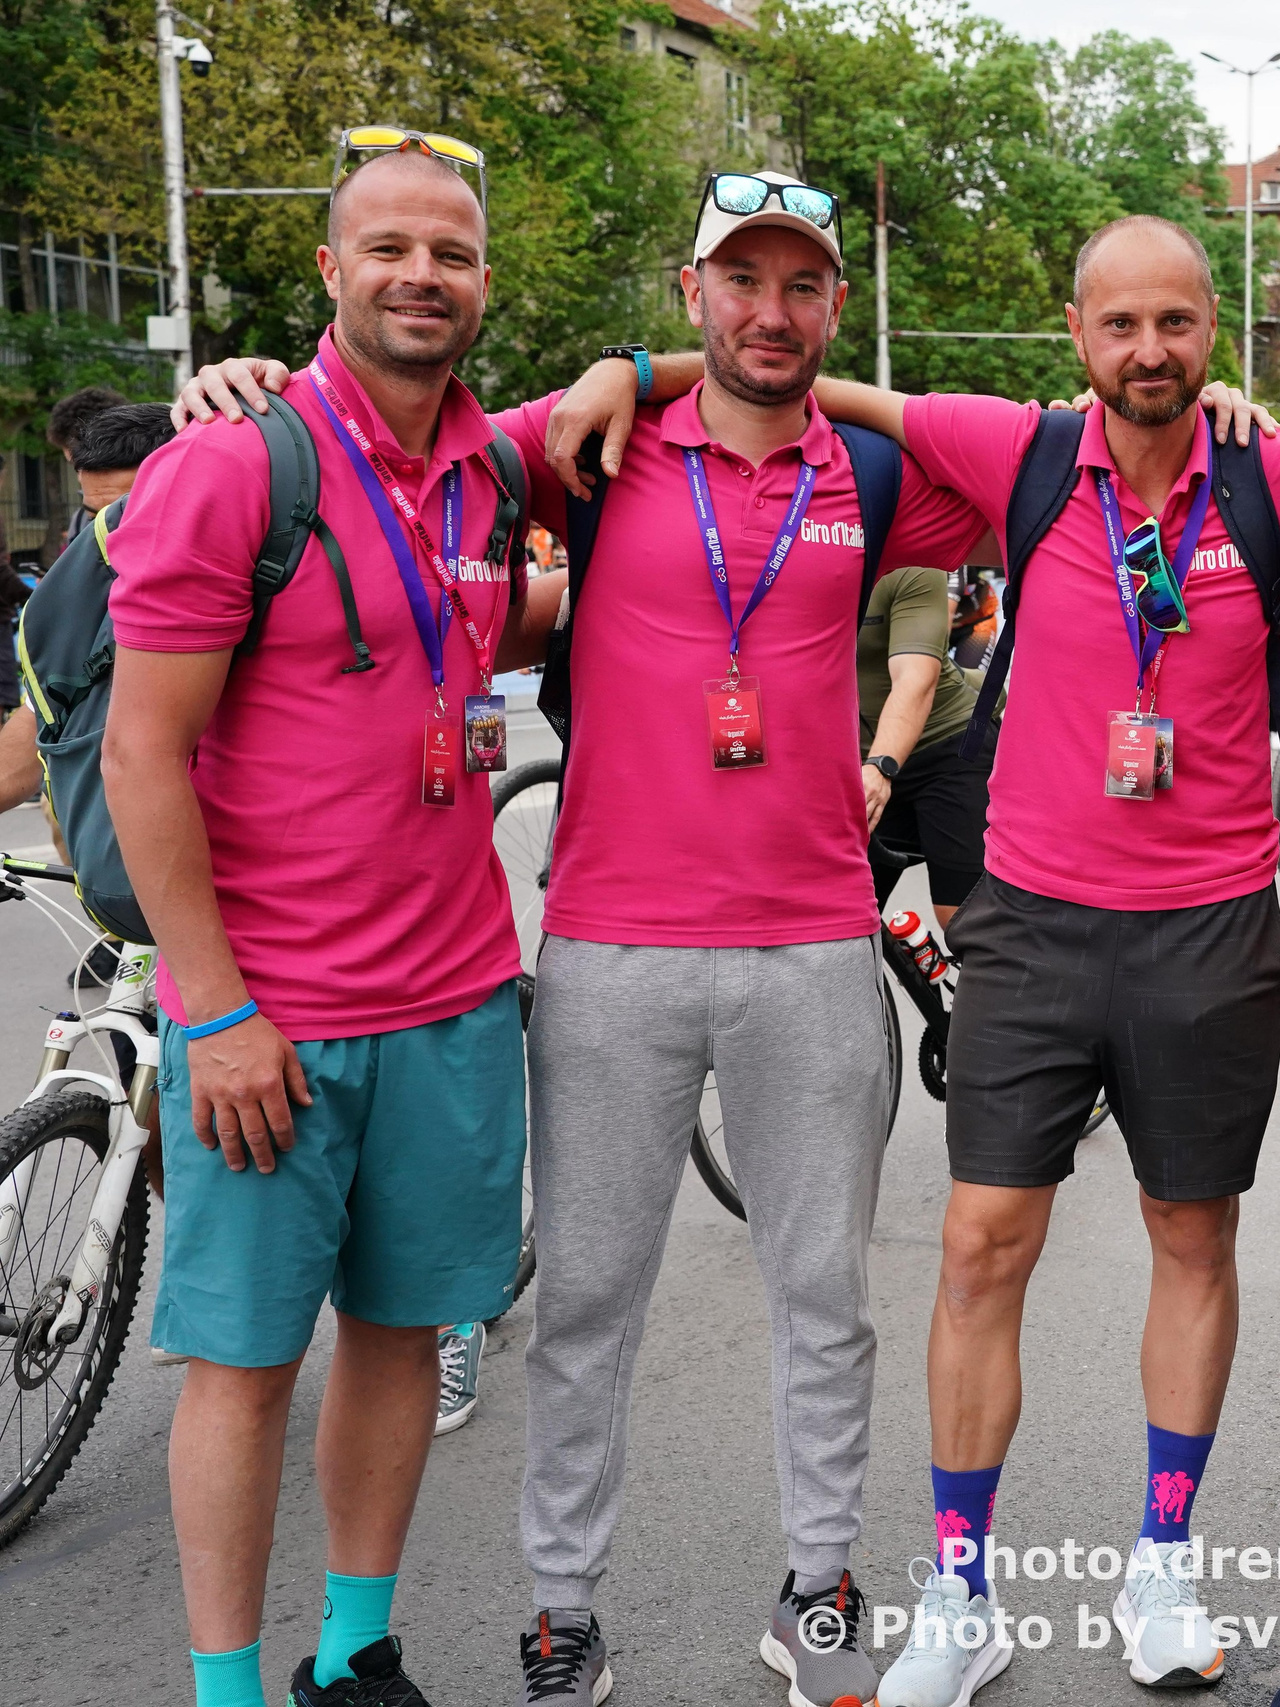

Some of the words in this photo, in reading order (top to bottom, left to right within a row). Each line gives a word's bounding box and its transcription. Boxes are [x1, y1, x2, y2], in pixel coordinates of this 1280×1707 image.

[358, 432, 371, 450] Giro
[692, 474, 702, 498] Partenza
[402, 503, 416, 518] Giro
[698, 498, 706, 518] Grande
[768, 554, 784, 570] Giro
[776, 534, 792, 558] d'Italia
[788, 506, 798, 526] Grande
[794, 484, 806, 506] Partenza
[801, 518, 830, 544] Giro
[831, 521, 864, 548] d'Italia
[1106, 510, 1114, 536] Partenza
[706, 526, 720, 550] d'Italia
[1110, 536, 1118, 556] Grande
[712, 550, 724, 566] Giro
[442, 571, 454, 586] Giro
[458, 555, 484, 582] Giro
[1122, 586, 1132, 600] Giro
